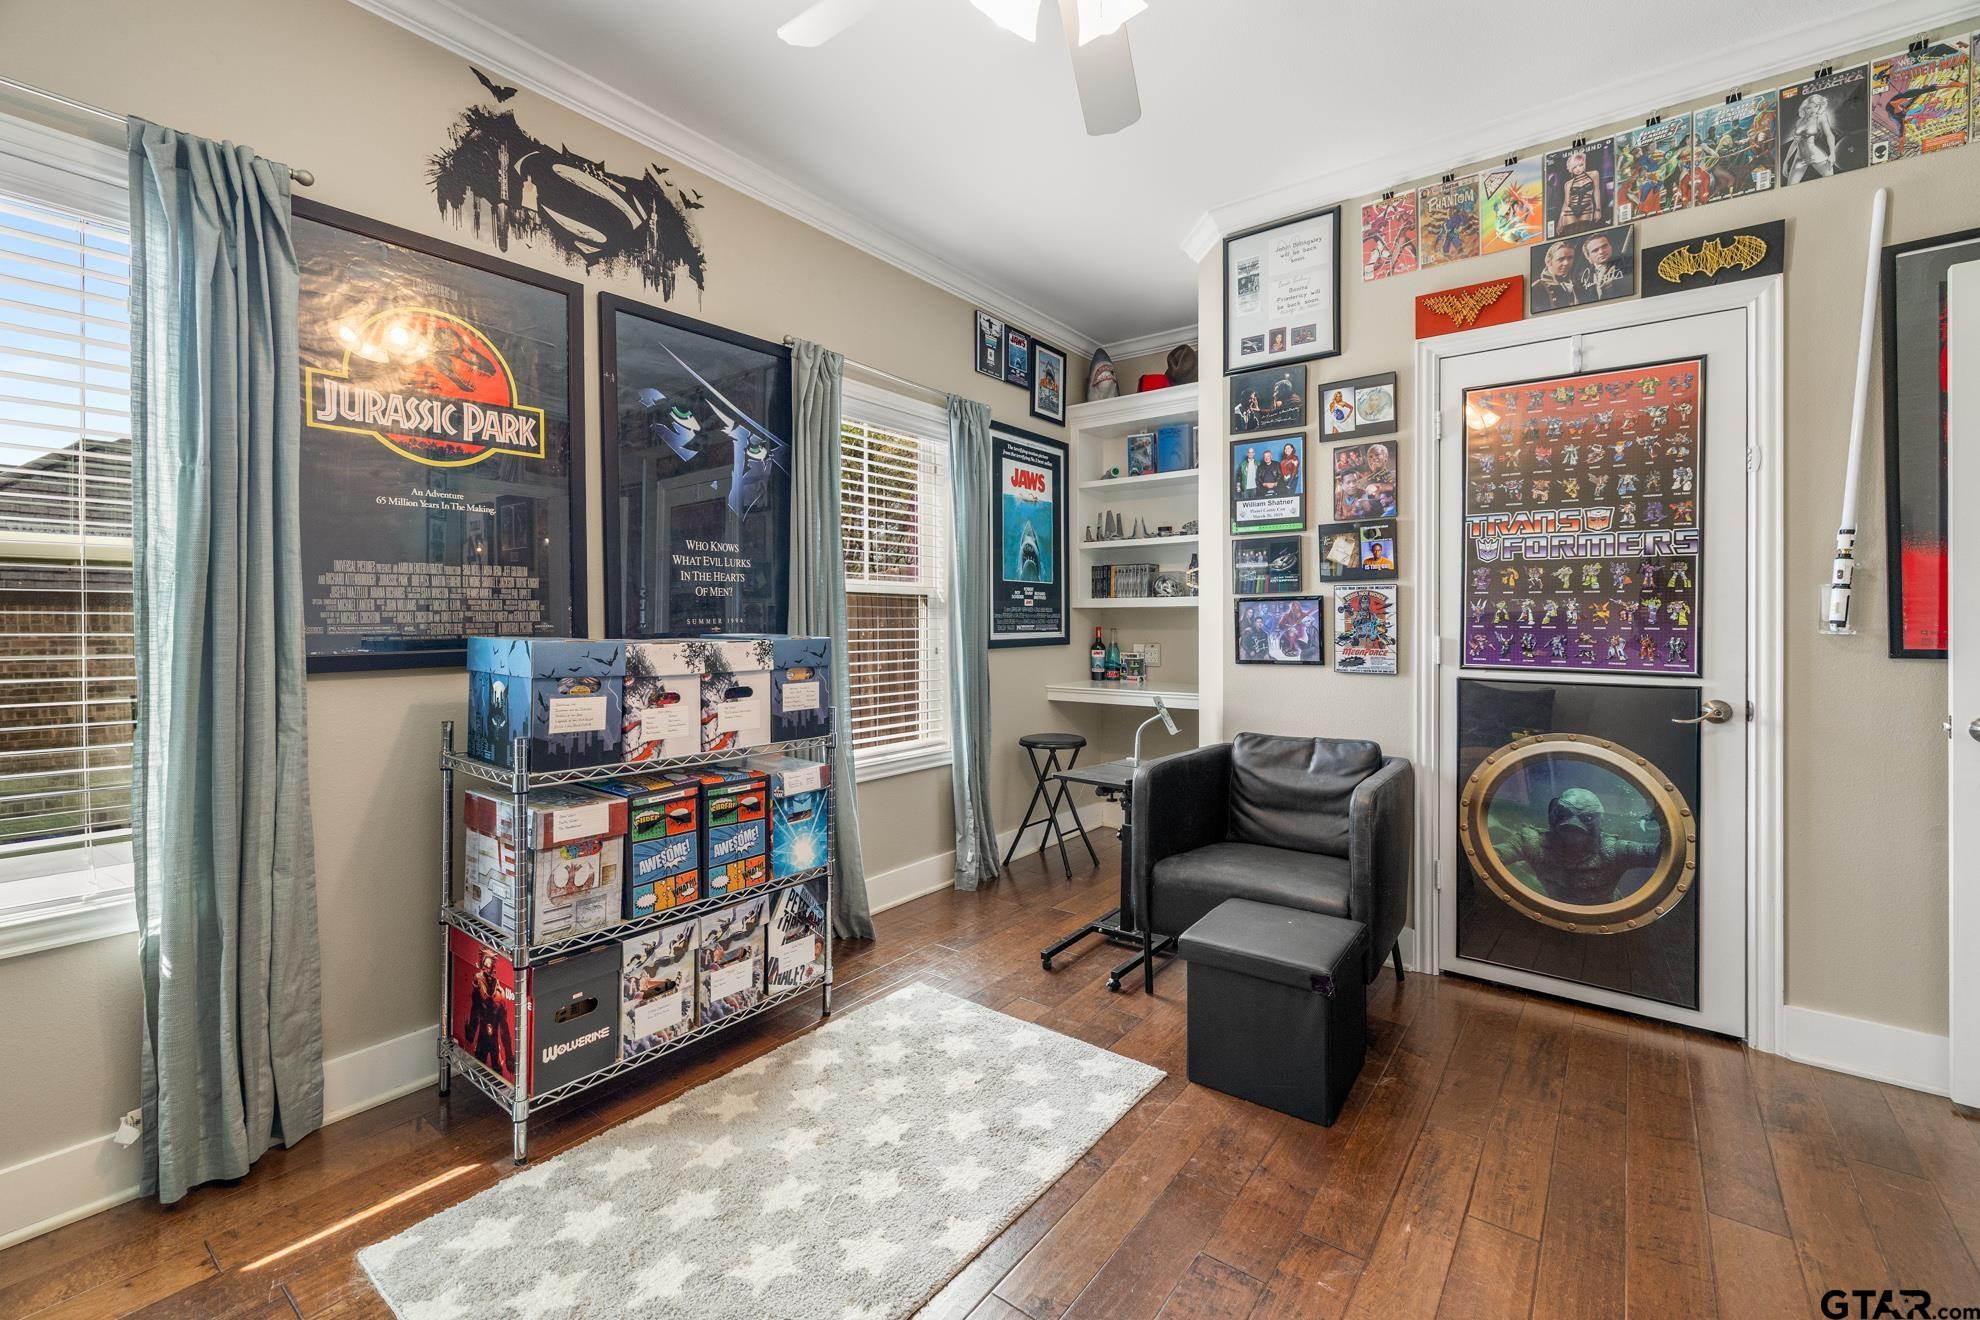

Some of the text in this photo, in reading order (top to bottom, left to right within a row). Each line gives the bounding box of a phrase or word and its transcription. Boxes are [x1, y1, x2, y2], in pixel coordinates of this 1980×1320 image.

[1802, 75, 1864, 95] GALACTICA
[1428, 189, 1475, 213] PHANTOM
[317, 378, 538, 447] JURASSIC PARK
[1011, 467, 1046, 493] JAWS
[376, 496, 387, 505] 65
[388, 497, 418, 507] Million
[419, 499, 440, 509] Years
[441, 500, 450, 509] In
[450, 501, 465, 511] The
[411, 487, 464, 500] An Adventure
[1267, 499, 1294, 507] Shatner
[1501, 528, 1699, 561] FORMERS
[713, 826, 759, 858] AWESOME!
[640, 839, 691, 875] AWESOME!
[542, 1026, 610, 1064] WOLVERINE
